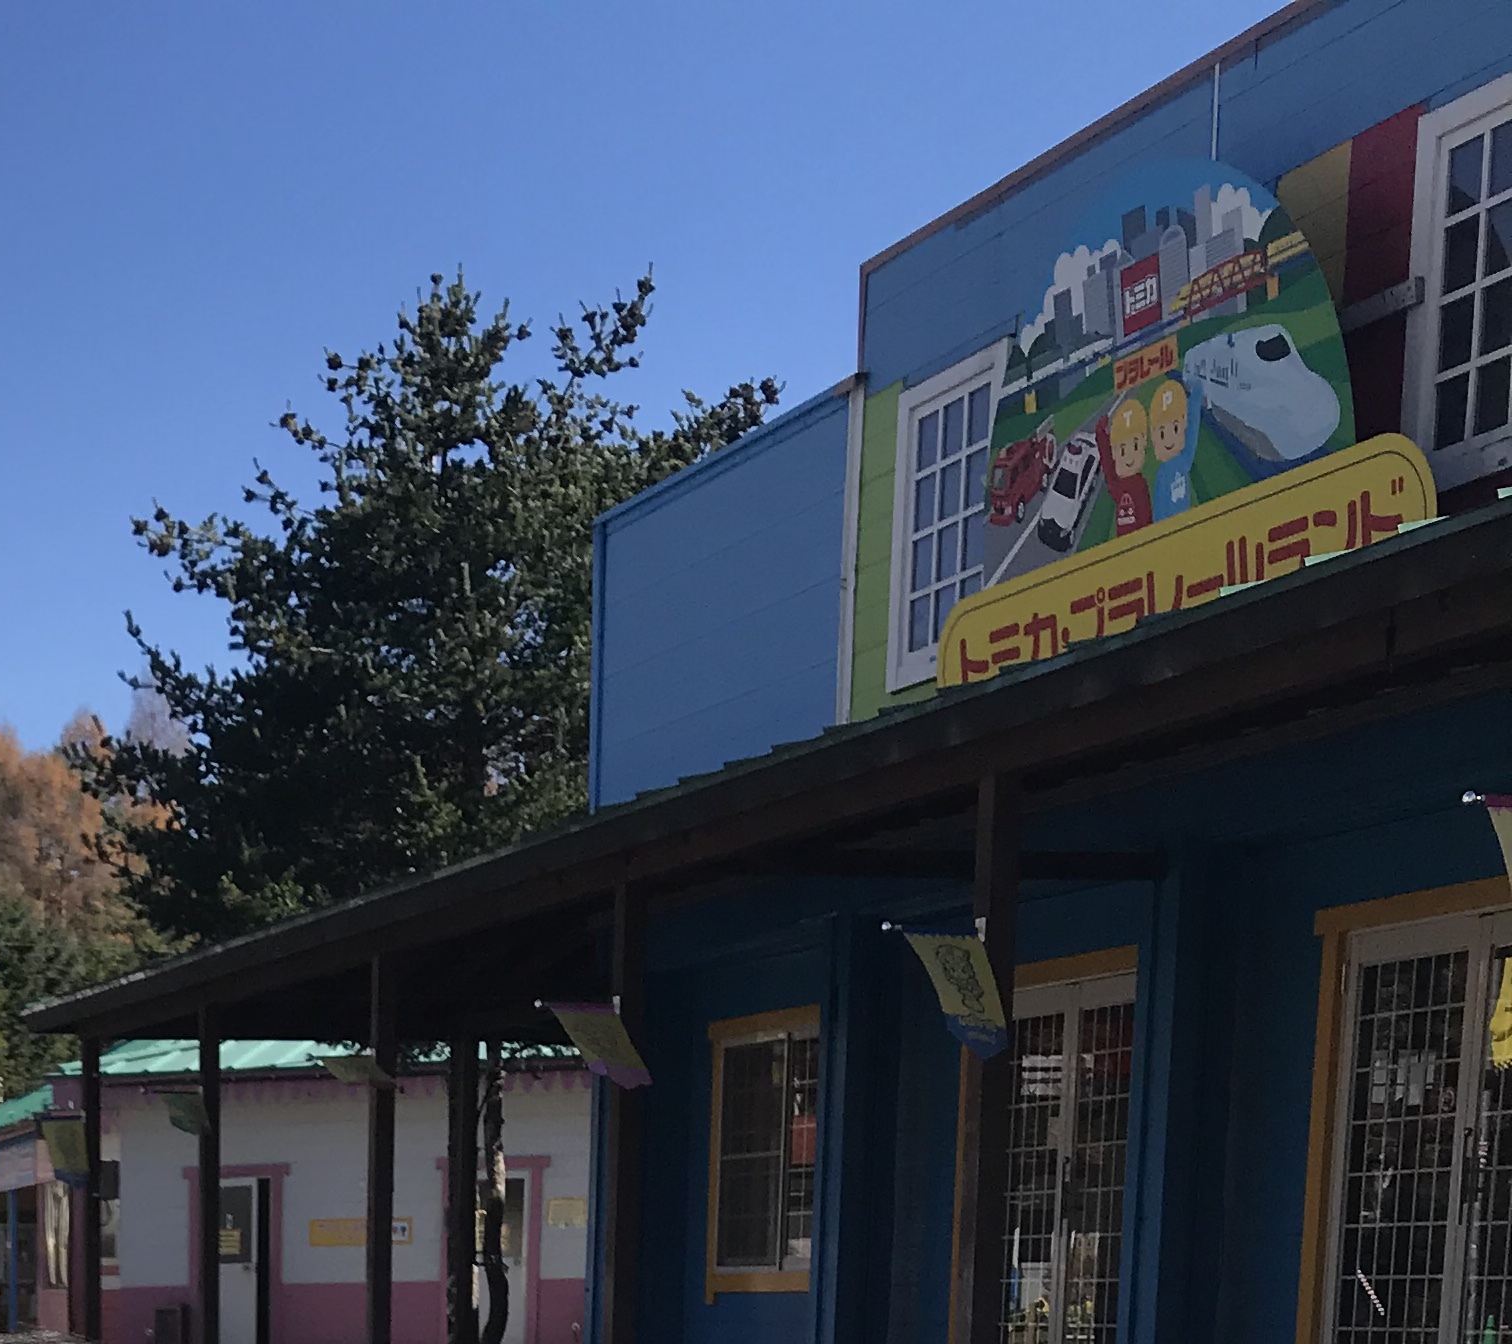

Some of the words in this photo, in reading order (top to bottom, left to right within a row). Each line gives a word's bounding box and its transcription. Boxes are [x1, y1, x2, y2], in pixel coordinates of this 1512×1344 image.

[1123, 275, 1158, 317] トミカ
[1162, 391, 1173, 411] P
[1123, 410, 1133, 427] T
